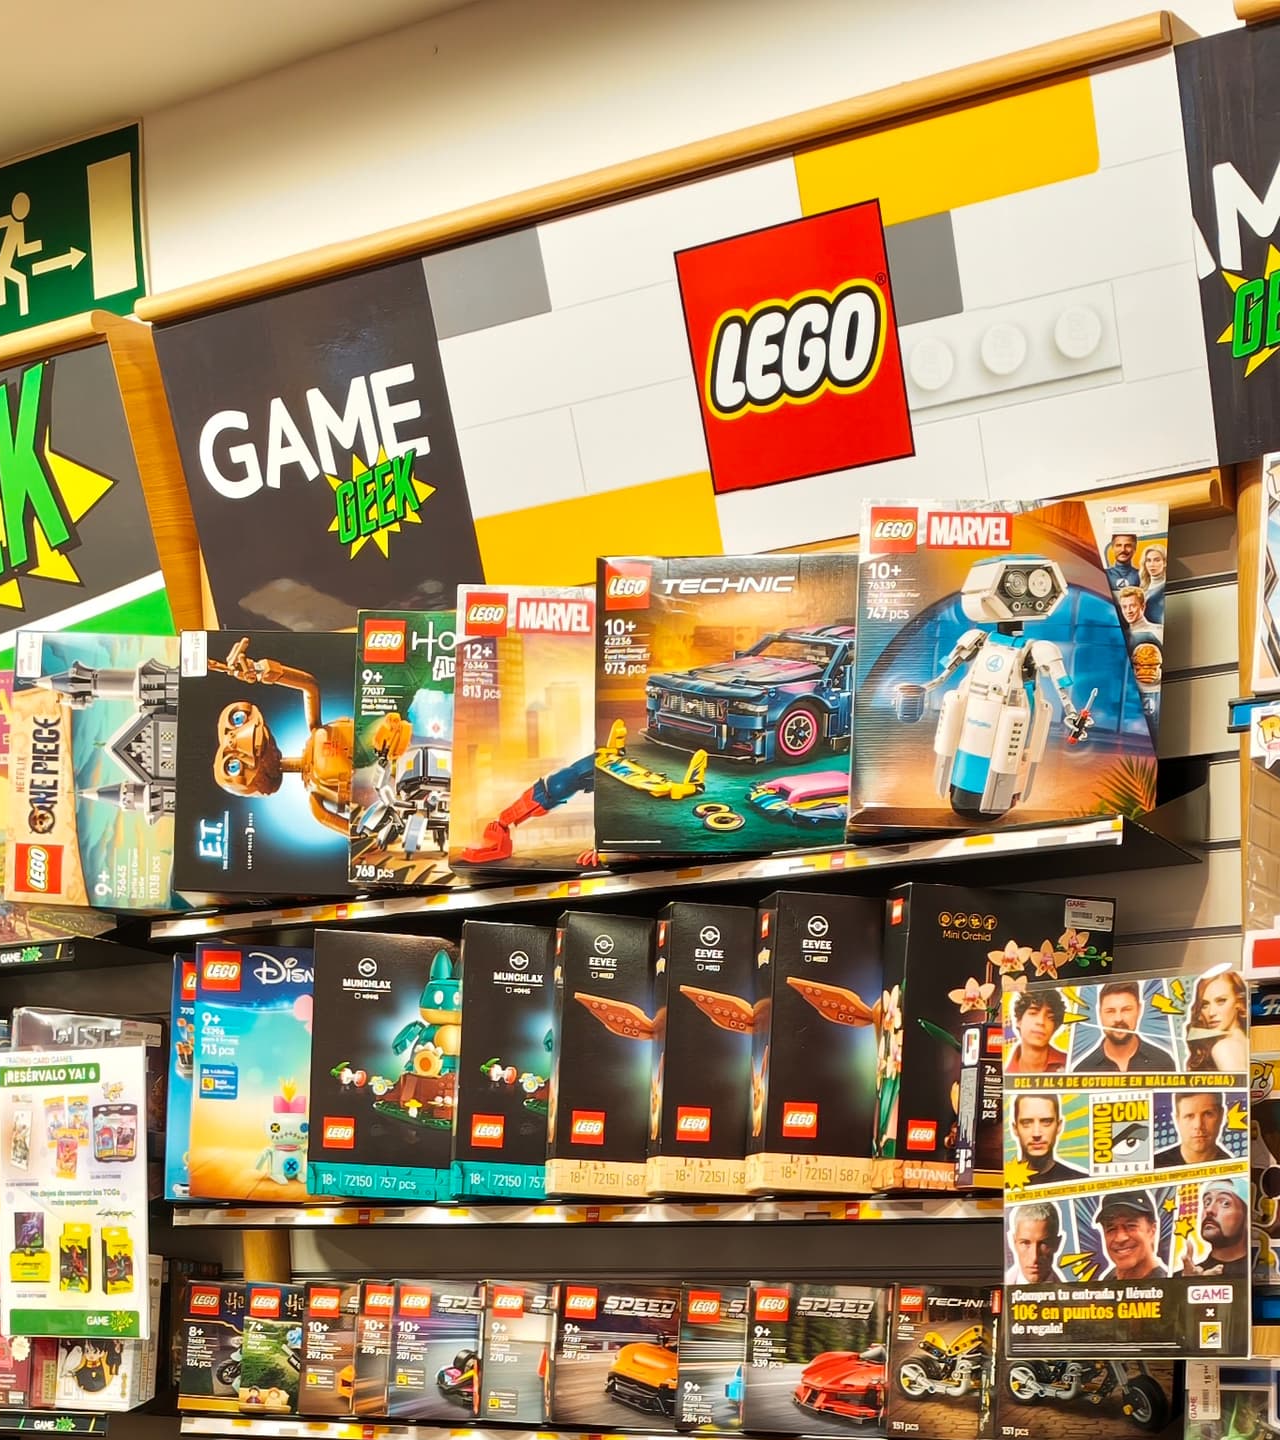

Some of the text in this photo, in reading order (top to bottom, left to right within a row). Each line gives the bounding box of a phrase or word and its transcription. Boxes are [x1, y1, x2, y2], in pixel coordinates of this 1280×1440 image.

[711, 284, 884, 414] LEGO
[199, 364, 429, 499] GAME
[334, 450, 421, 544] GEEK
[872, 515, 1011, 548] LEGO MARVEL
[608, 575, 795, 597] LEGO TECHNIC
[942, 928, 992, 941] Mini Orchid
[589, 957, 617, 968] EEVEE
[343, 978, 392, 990] MUNCHLAX
[493, 971, 544, 985] MUNCHLAX
[1014, 1075, 1235, 1088] DEL 1 AL 4 DE OCTUBRE EN MÁLAGA (FYCMA)
[1113, 1101, 1149, 1121] CON
[1094, 1103, 1112, 1163] COMIC
[1012, 1287, 1163, 1302] ¡Compra tu entrada y llévate
[1191, 1288, 1230, 1300] GAME
[1012, 1302, 1160, 1321] 10€ en puntos GAME
[1012, 1323, 1063, 1335] de regalo!
